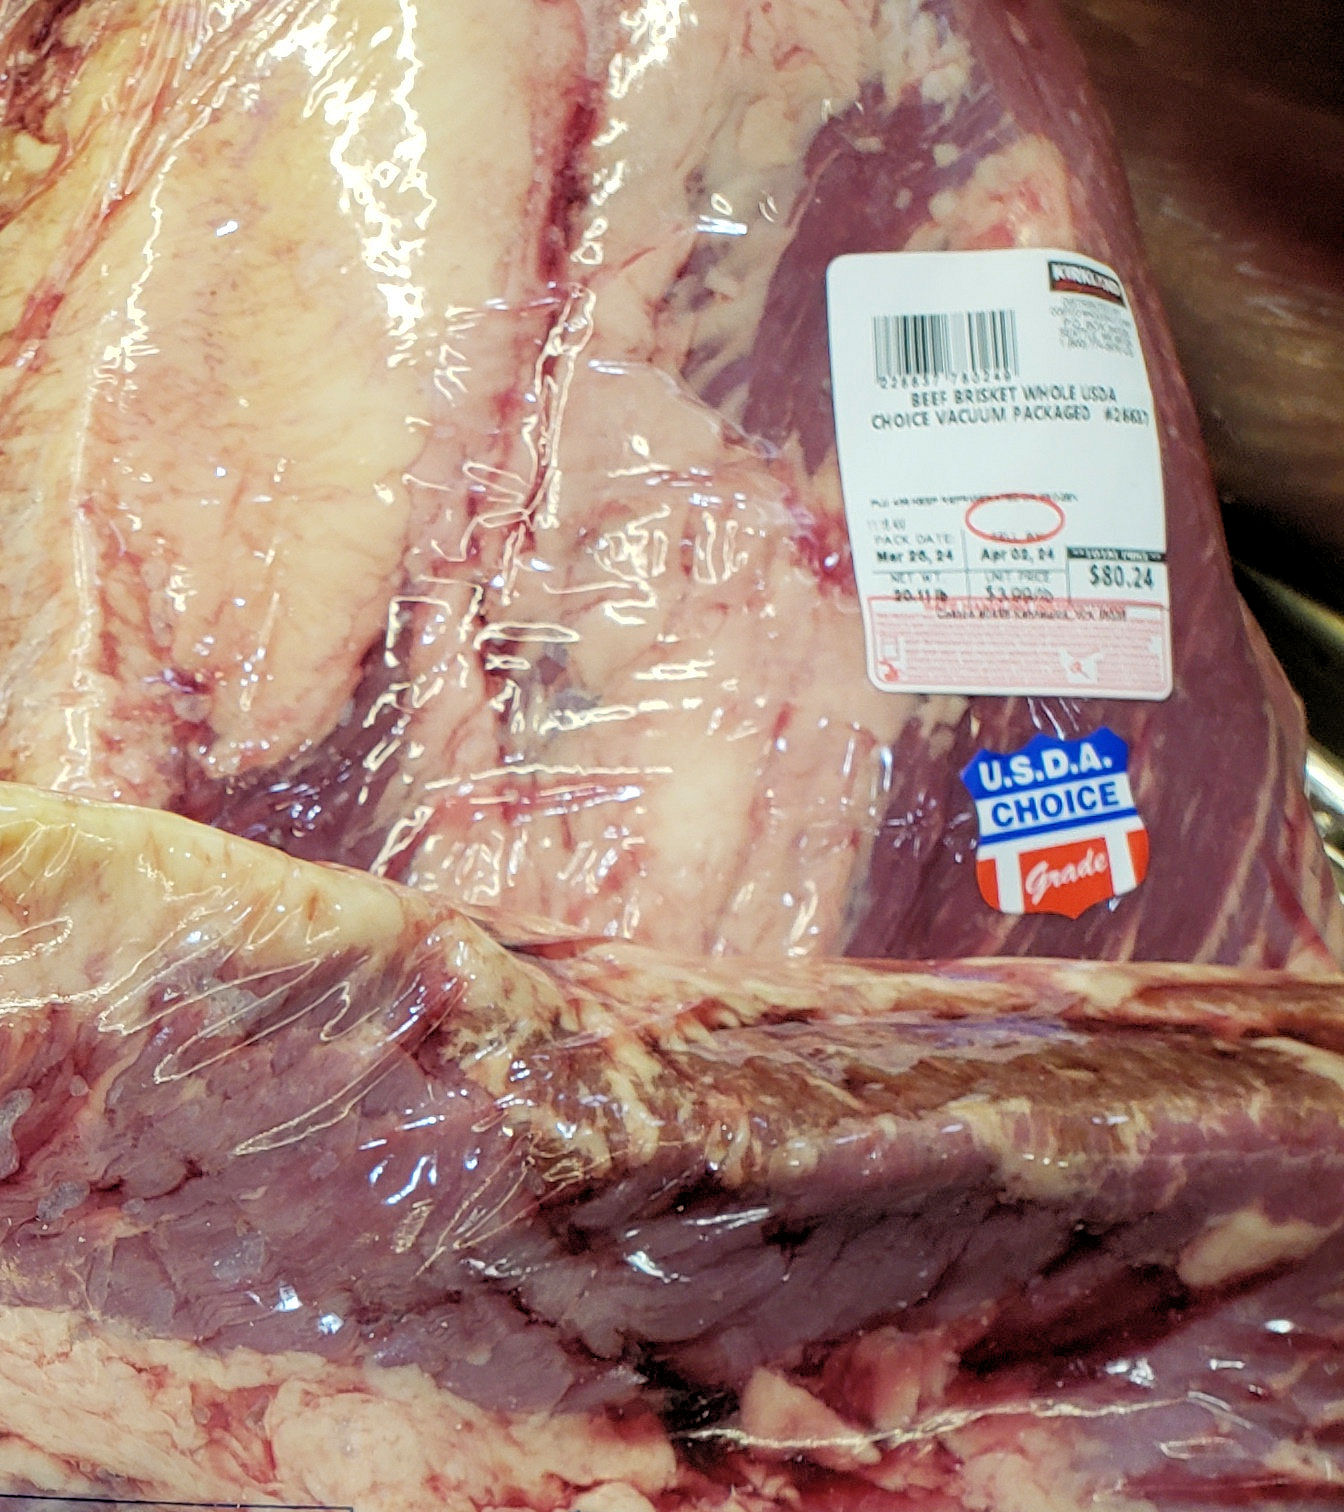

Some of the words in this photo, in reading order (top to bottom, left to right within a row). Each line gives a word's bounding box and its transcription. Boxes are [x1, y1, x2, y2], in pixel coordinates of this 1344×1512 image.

[912, 390, 948, 408] BEEF
[954, 387, 1018, 404] BRISKET
[1023, 384, 1075, 401] WHOLE
[1081, 385, 1117, 401] USDA
[871, 412, 929, 430] CHOICE
[937, 408, 1006, 425] VACUUM
[1013, 406, 1091, 421] PACKAGED
[981, 547, 1009, 564] Apr
[1089, 564, 1154, 589] $80.24
[978, 742, 1112, 792] U.S.D.A.
[992, 781, 1119, 827] CHOICE
[1025, 847, 1109, 905] Grade
